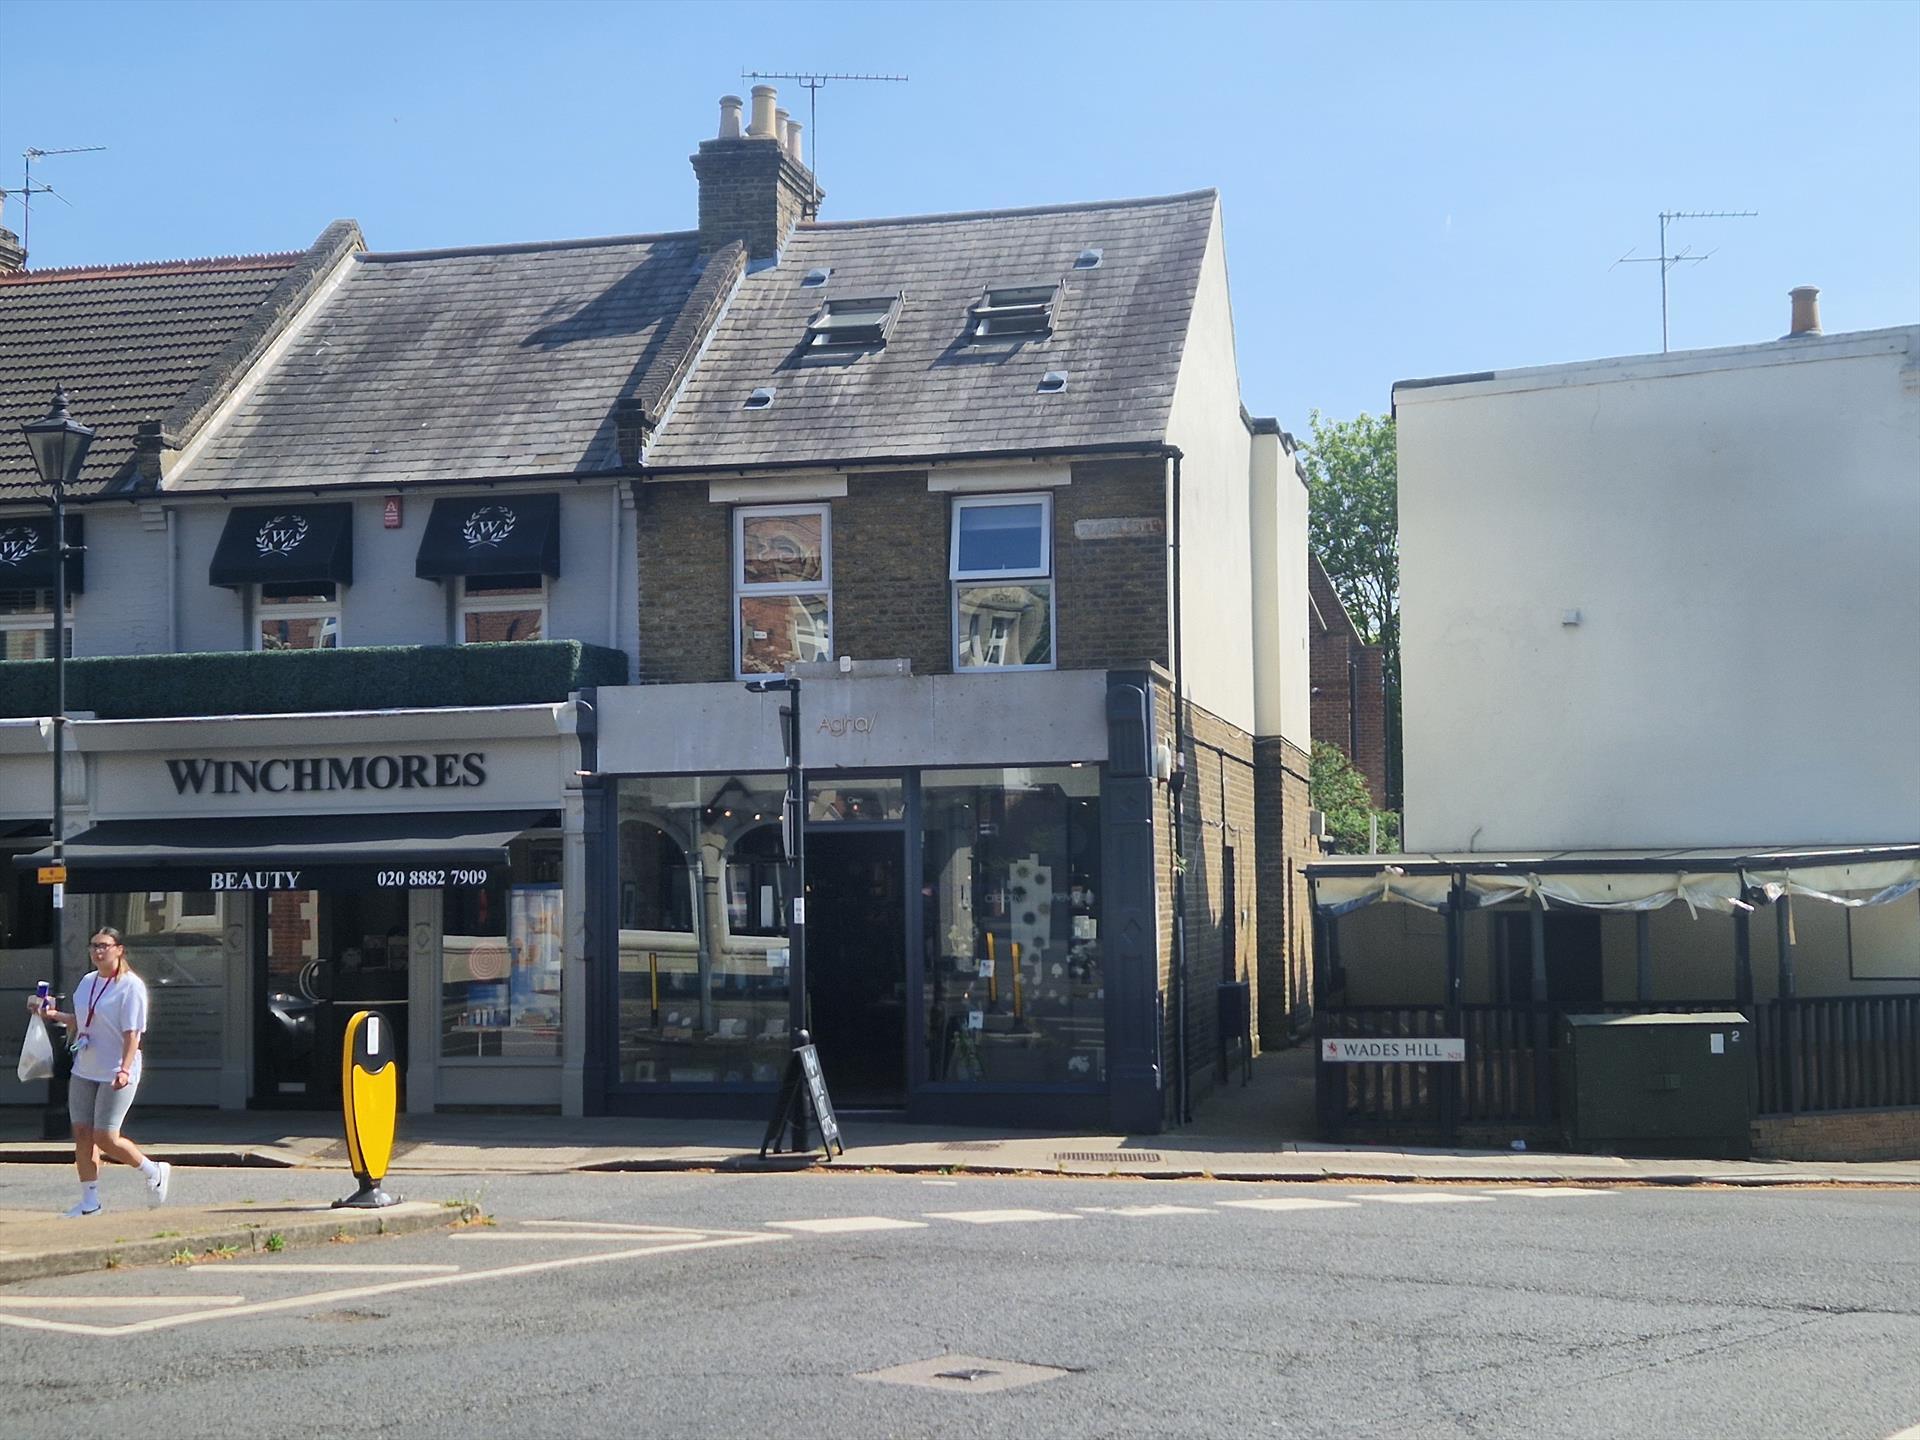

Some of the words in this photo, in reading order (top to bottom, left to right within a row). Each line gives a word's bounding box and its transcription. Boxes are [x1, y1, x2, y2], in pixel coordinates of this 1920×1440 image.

[479, 520, 501, 533] W
[272, 529, 294, 543] W
[3, 540, 24, 554] W
[166, 753, 487, 795] WINCHMORES
[210, 870, 301, 890] BEAUTY
[377, 870, 406, 887] 020
[409, 870, 446, 887] 8882
[450, 868, 487, 886] 7909
[1731, 1030, 1741, 1042] 2
[1344, 1043, 1400, 1056] WADES
[1405, 1043, 1442, 1056] HILL
